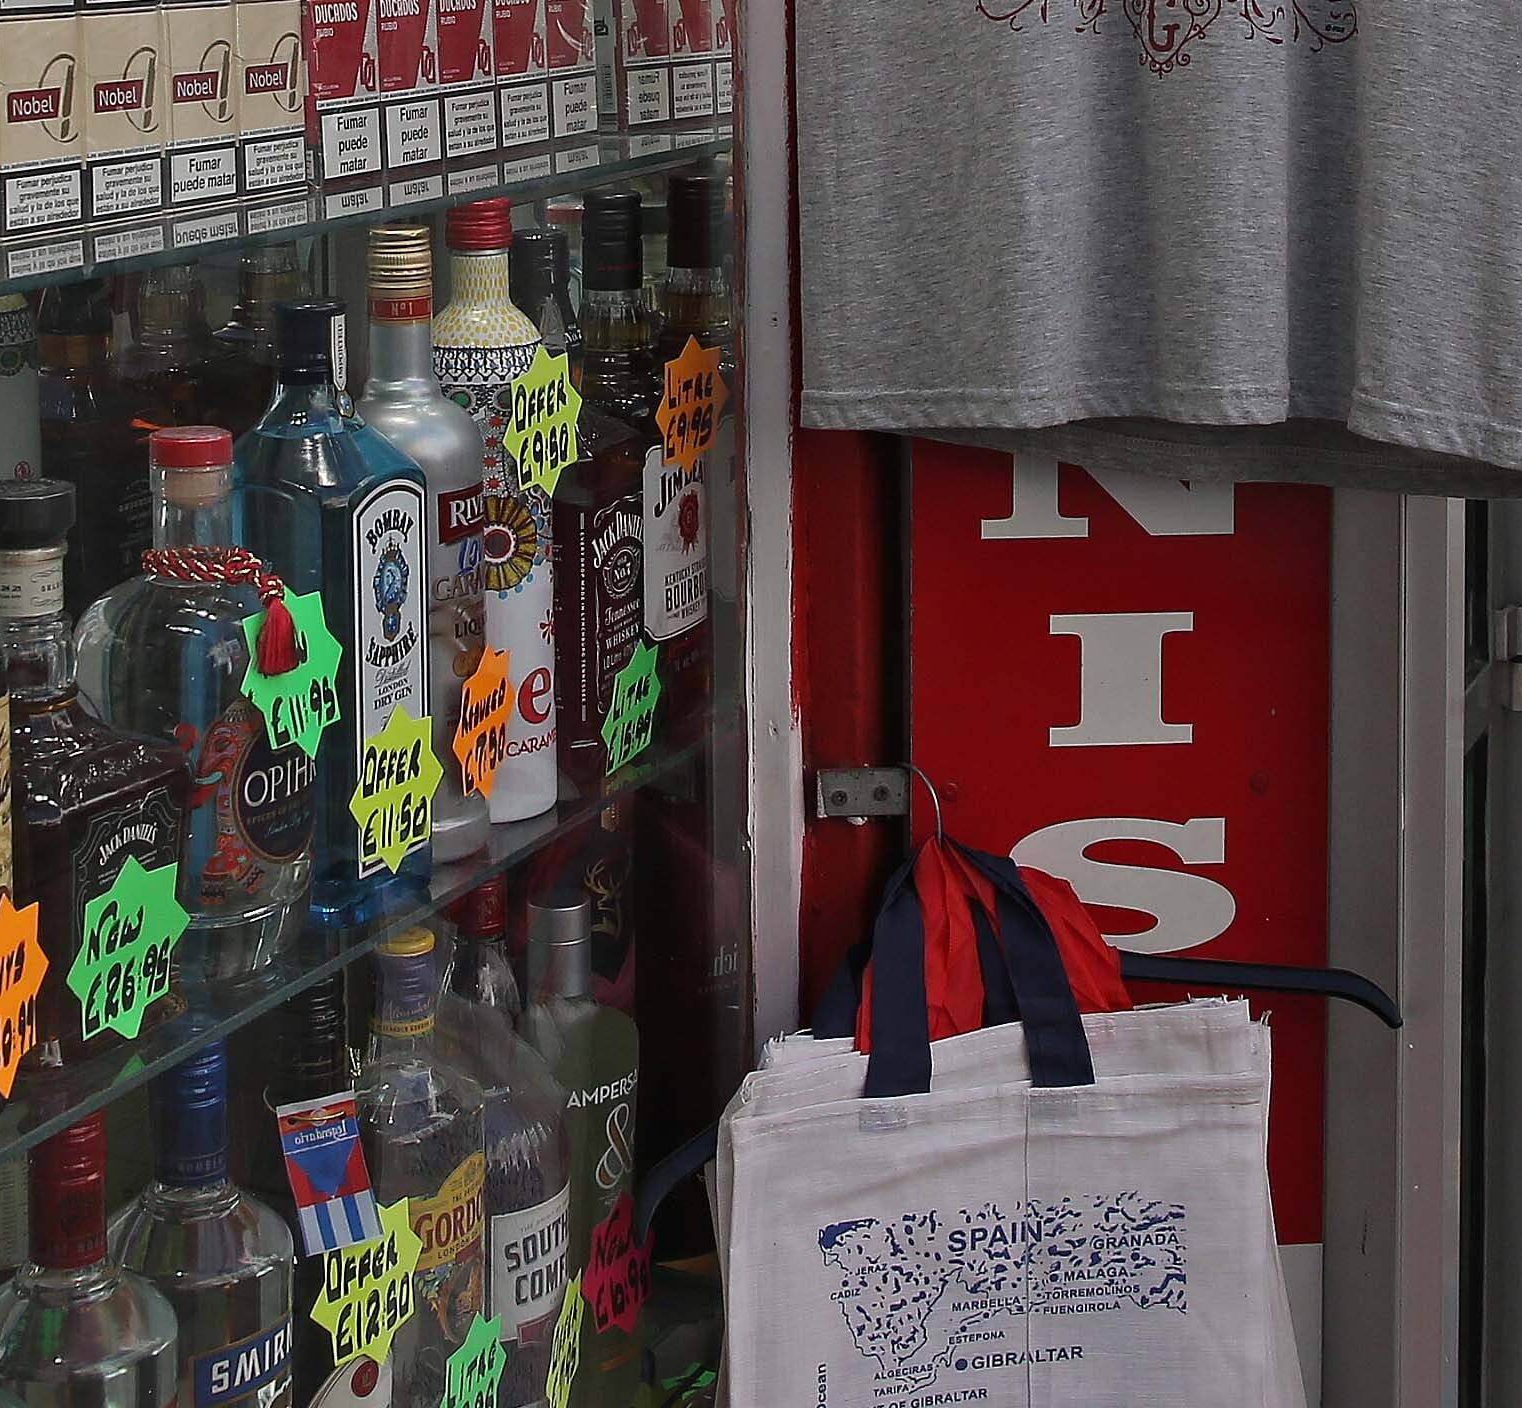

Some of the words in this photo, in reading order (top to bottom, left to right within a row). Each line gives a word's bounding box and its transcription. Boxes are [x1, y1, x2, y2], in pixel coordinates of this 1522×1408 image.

[316, 2, 358, 25] DUCADOS
[13, 95, 54, 117] Nobel
[515, 372, 569, 432] OFFER
[366, 509, 415, 555] BOMBAY
[592, 522, 618, 570] JACK
[365, 620, 419, 668] SAPPHIRE
[605, 623, 641, 652] WHISKEY
[373, 693, 395, 711] DRY
[395, 684, 413, 703] GIN
[377, 678, 409, 696] LONDON
[362, 735, 420, 799] OFFER
[98, 835, 123, 867] JACK
[503, 1204, 570, 1273] SOUTH
[947, 1219, 1044, 1254] SPAIN
[1091, 1232, 1179, 1252] GRANADA
[855, 1263, 888, 1277] JERAZ
[1063, 1265, 1129, 1282] MALAGA
[829, 1287, 862, 1302] CADIZ
[1044, 1283, 1141, 1301] TORREMOLINOS
[950, 1295, 1021, 1313] MARBELLA
[1042, 1300, 1122, 1316] FUENGIROLA
[948, 1330, 1006, 1345] ESTEPONA
[971, 1345, 1085, 1371] GIBRALTAR
[873, 1362, 935, 1382] ALGECIRAS
[873, 1382, 911, 1398] TARIFA
[909, 1386, 989, 1408] GIBRALTAR
